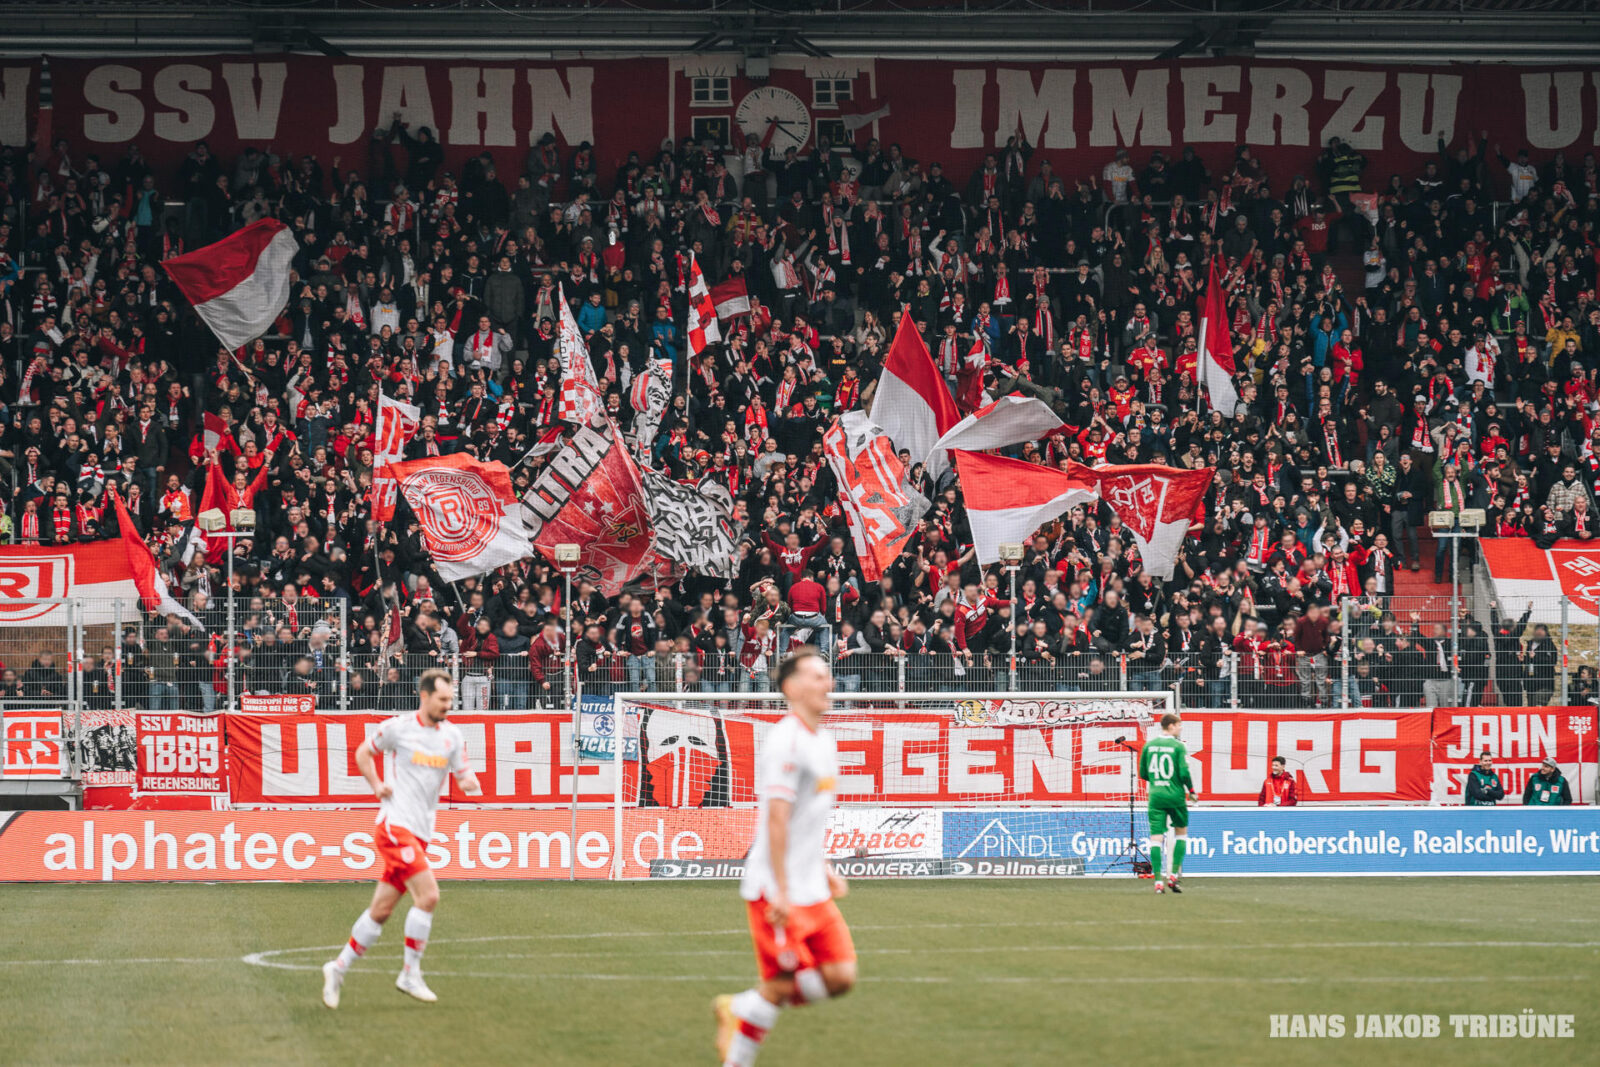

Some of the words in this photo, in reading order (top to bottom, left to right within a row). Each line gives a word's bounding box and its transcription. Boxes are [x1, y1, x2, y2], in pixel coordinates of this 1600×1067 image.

[83, 64, 288, 143] SSV
[328, 64, 595, 147] JAHN
[950, 65, 1463, 153] IMMERZU
[1520, 72, 1600, 150] U
[429, 474, 481, 496] REGENSBURG
[477, 500, 490, 512] 89
[141, 716, 171, 731] SSV
[177, 717, 219, 732] JAHN
[1447, 714, 1557, 759] JAHN
[141, 735, 220, 773] 1889
[1148, 753, 1175, 779] 40
[82, 771, 136, 785] GENSBURG
[142, 777, 220, 790] REGENSBURG
[43, 820, 704, 880] alphatec-ssteme.de
[825, 828, 925, 854] lphatec
[984, 835, 1061, 857] PINDL
[1223, 830, 1407, 858] Fachoberschule,
[1414, 830, 1545, 857] Realschule,
[977, 862, 1077, 875] Dallmeier
